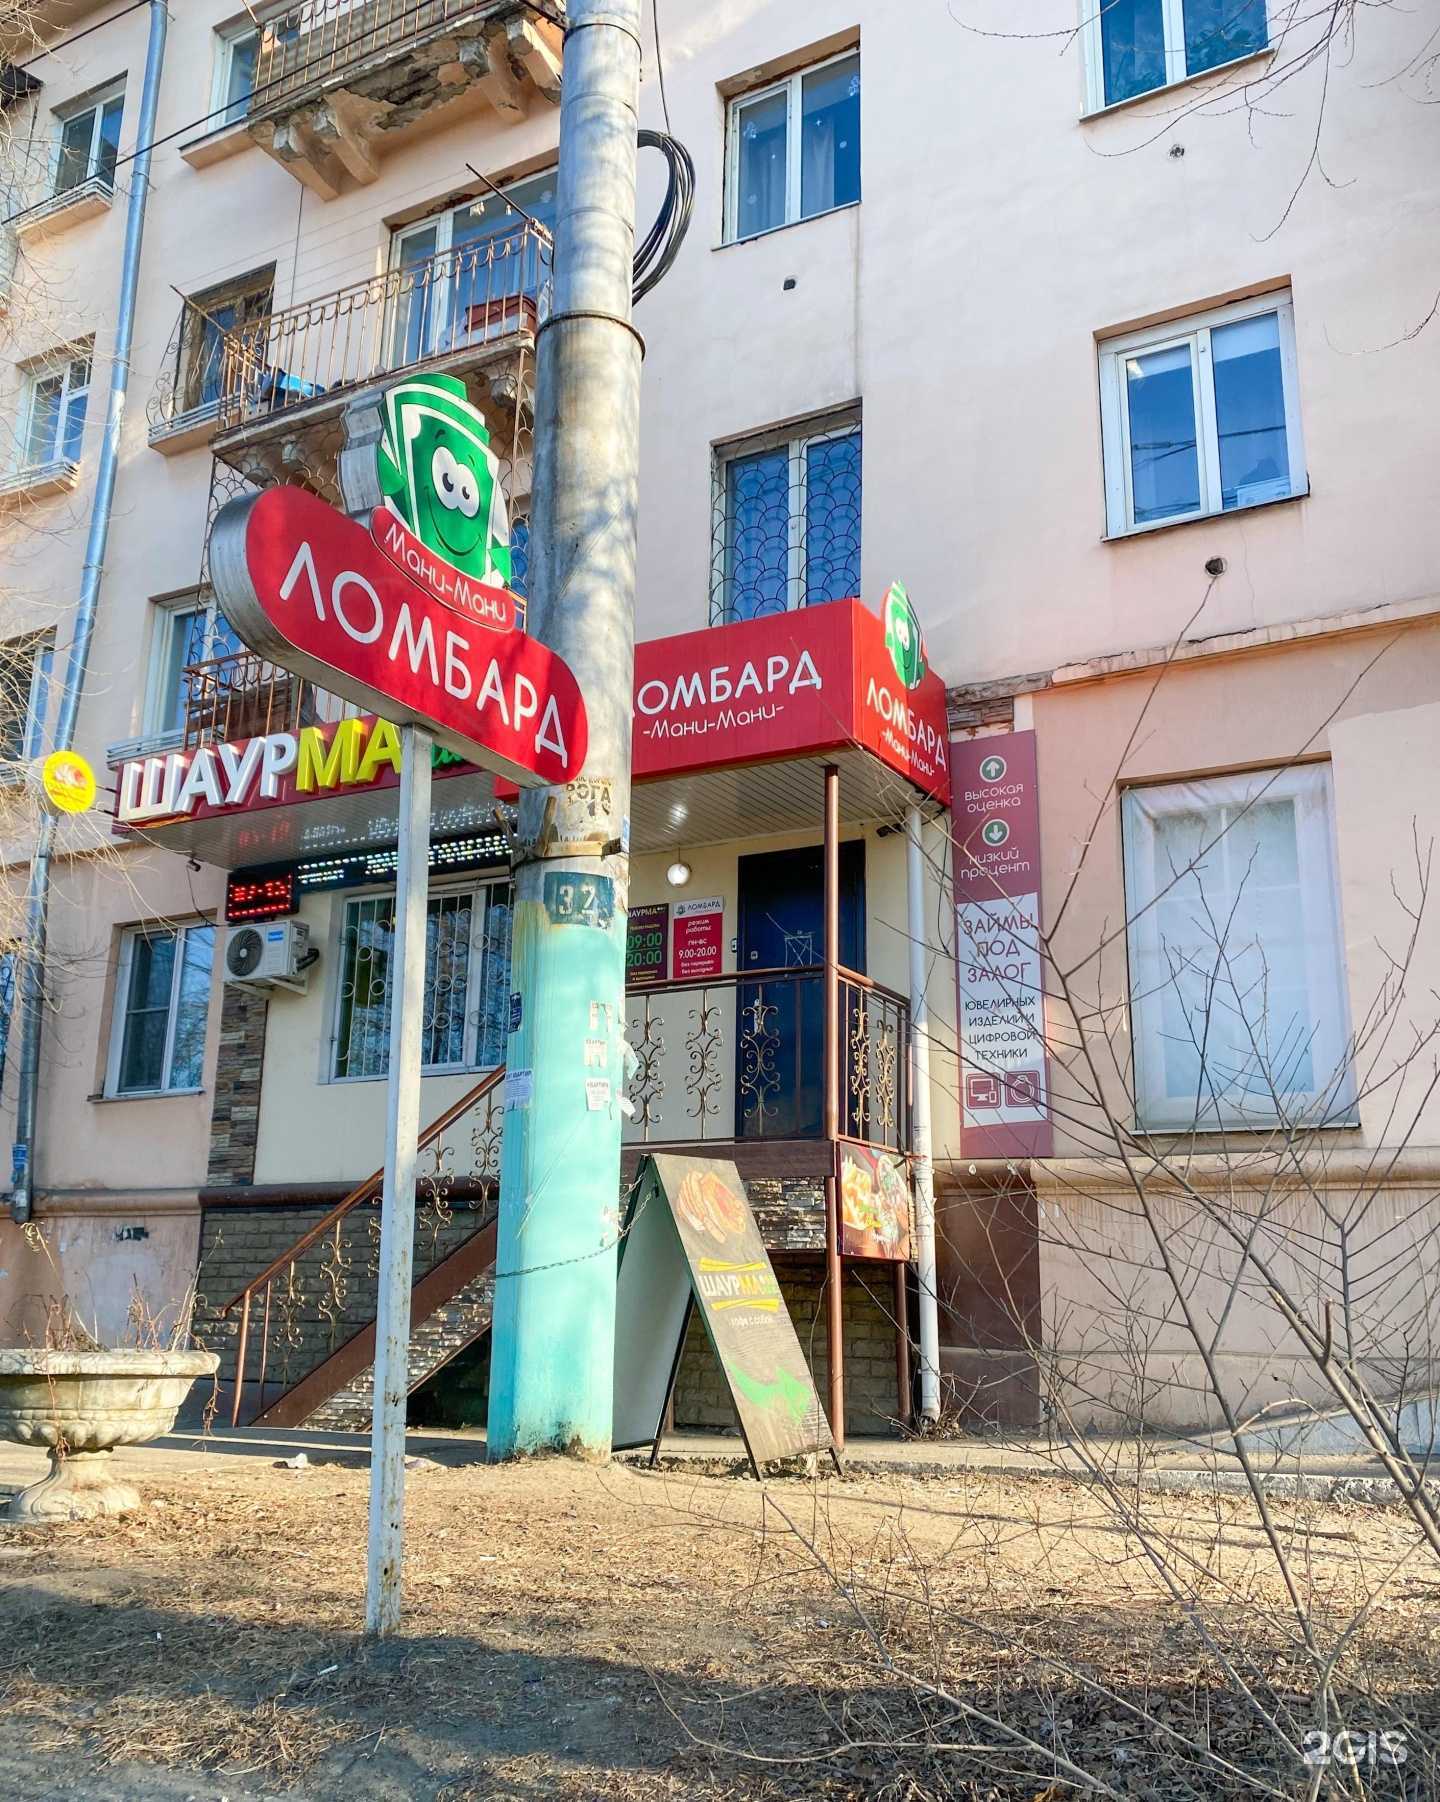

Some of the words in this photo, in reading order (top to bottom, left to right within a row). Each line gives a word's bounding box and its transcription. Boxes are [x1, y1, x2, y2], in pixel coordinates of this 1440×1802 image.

[384, 522, 507, 624] Мани-Мани
[280, 541, 568, 769] ЛОМБАРД
[633, 649, 823, 717] ОМБАРД
[866, 677, 947, 772] ЛОМБАРД
[116, 716, 401, 822] ШАУРМА
[964, 783, 1024, 801] высокая
[967, 797, 1022, 813] оценка
[969, 845, 1020, 865] низкий
[960, 861, 1030, 880] процент
[687, 900, 721, 911] ЛОМБАРД
[963, 912, 1034, 936] ЗАЙМЫ
[627, 931, 663, 949] 09:00
[976, 939, 1021, 958] ПОД
[627, 950, 662, 967] 20:00
[678, 945, 717, 959] 9.00-20.00
[967, 962, 1032, 983] ЗАЛОГ
[965, 996, 1036, 1012] ЮВЕЛИРНЫХ
[975, 1047, 1028, 1061] ТЕХНИКИ
